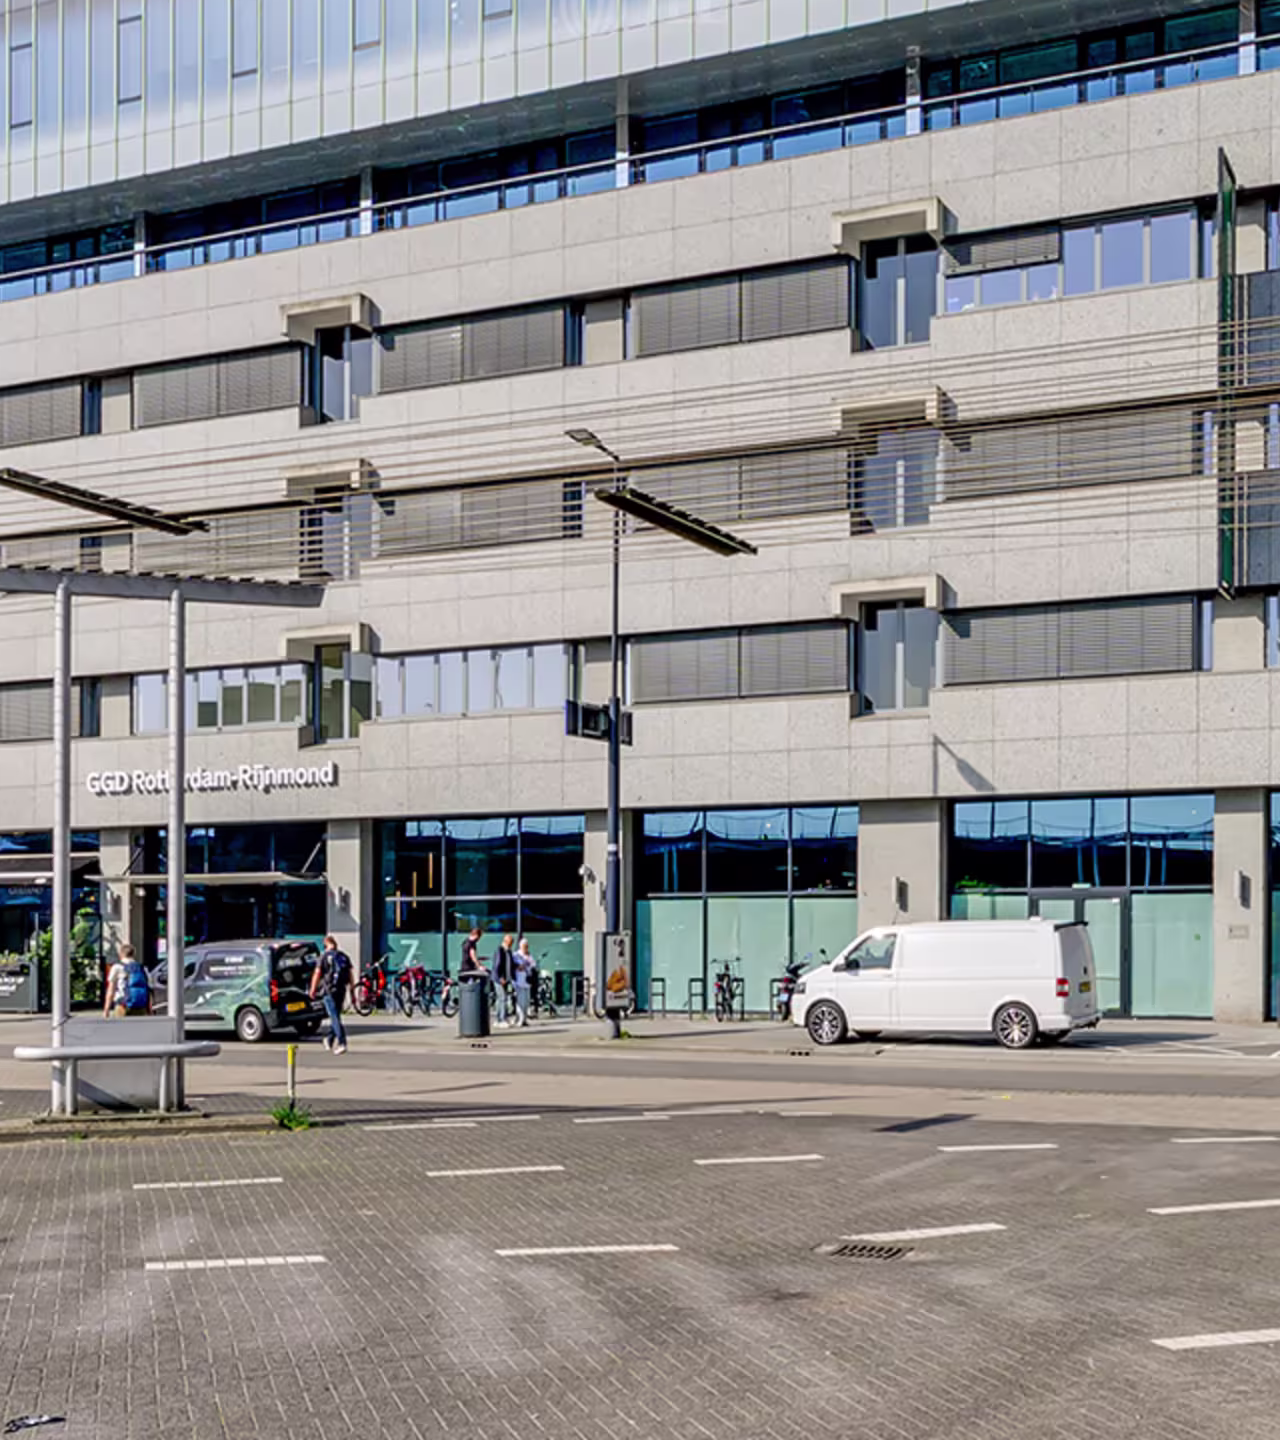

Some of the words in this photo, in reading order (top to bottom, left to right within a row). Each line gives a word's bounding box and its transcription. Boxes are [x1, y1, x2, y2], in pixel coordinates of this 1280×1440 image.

[86, 771, 130, 794] GGD
[132, 761, 335, 792] Rottrdam-Rijnmond
[400, 939, 419, 968] 7
